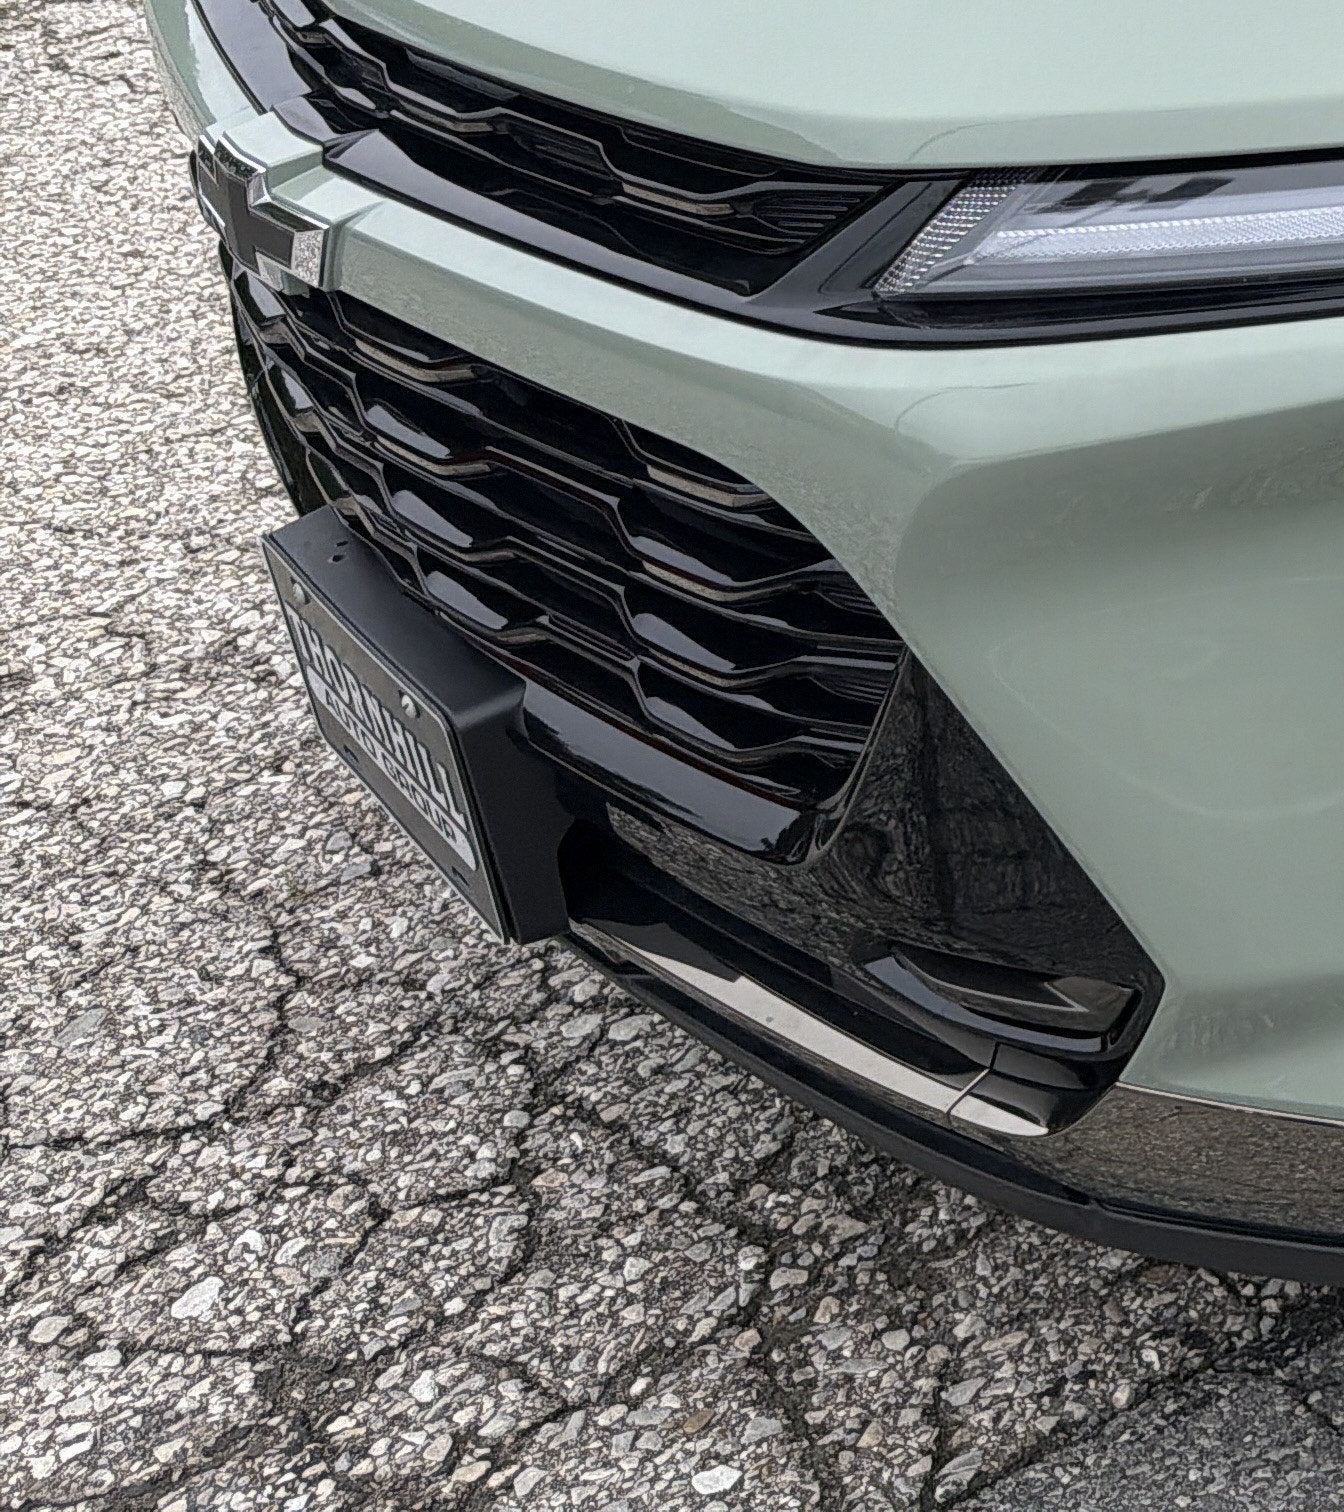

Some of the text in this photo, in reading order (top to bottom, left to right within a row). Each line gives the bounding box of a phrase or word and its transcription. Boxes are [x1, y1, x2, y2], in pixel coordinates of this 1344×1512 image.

[285, 601, 468, 834] THORNHILL
[324, 688, 458, 846] AUTO GROUP
